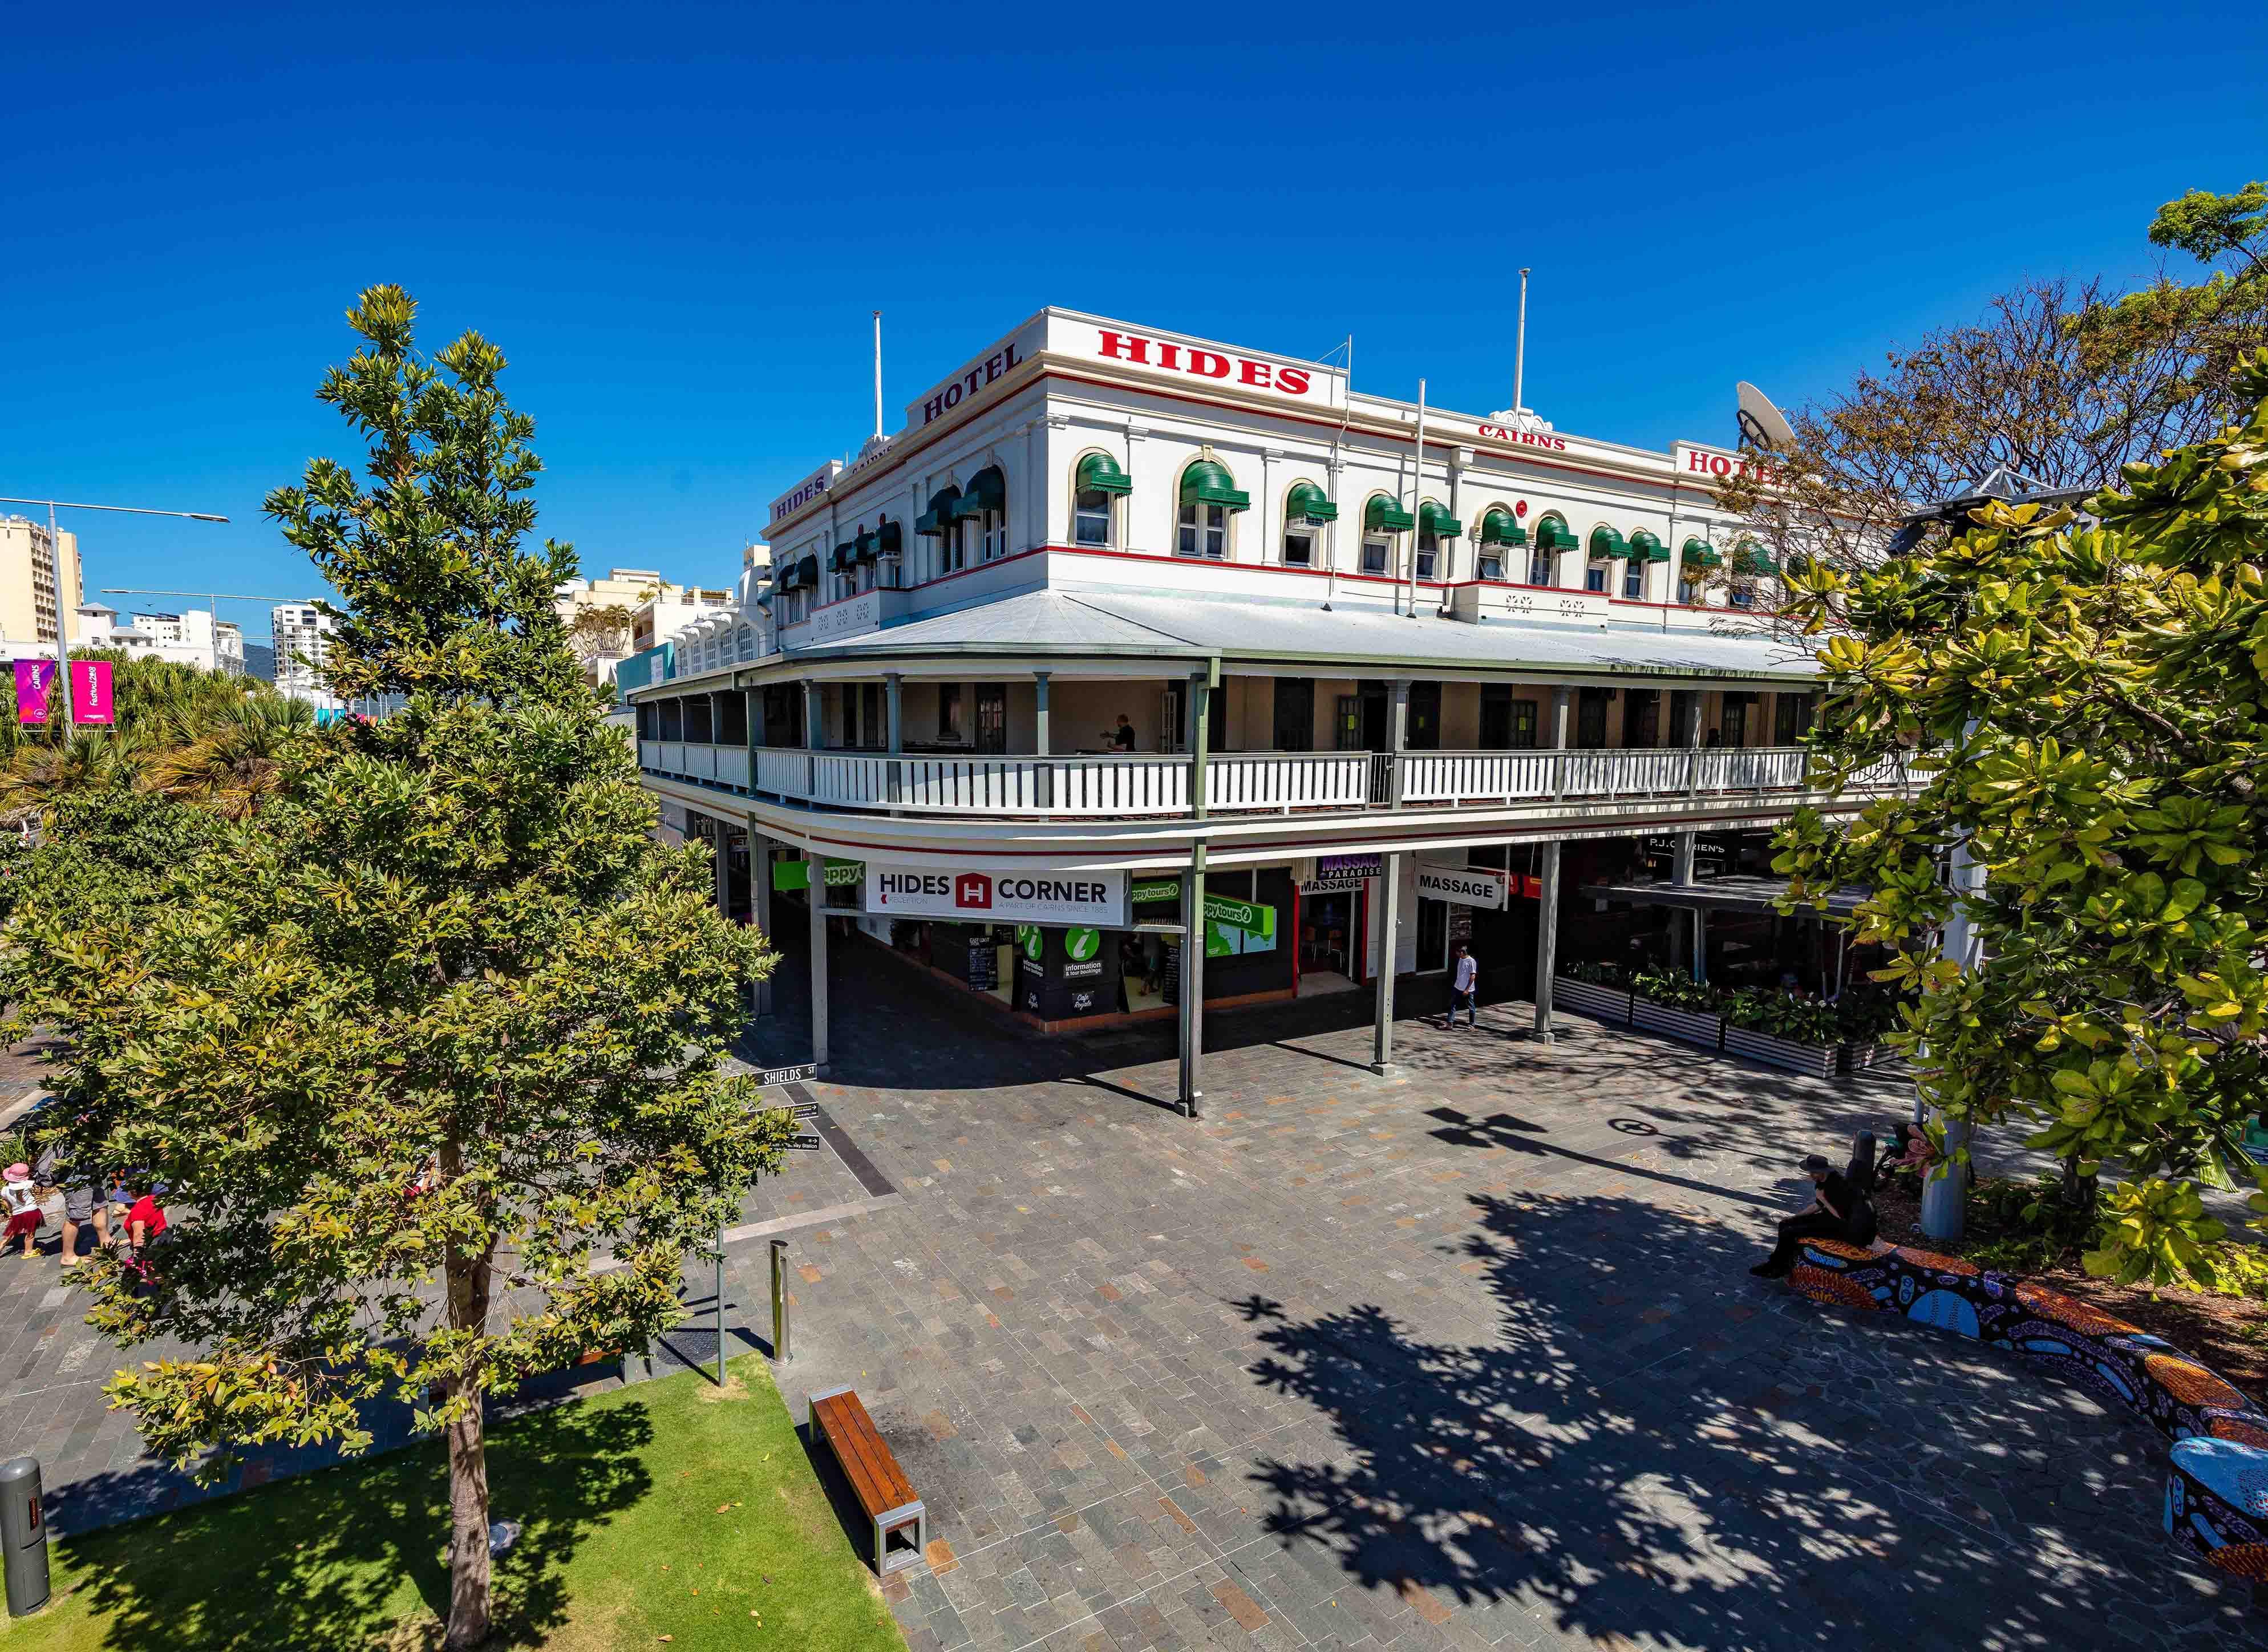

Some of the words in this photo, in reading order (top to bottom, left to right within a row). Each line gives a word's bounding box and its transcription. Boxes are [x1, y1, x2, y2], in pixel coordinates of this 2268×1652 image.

[1098, 330, 1311, 395] HIDES
[924, 342, 1022, 425] HOTEL
[1479, 424, 1566, 451] CAIRNS
[776, 475, 825, 520] HIDES
[31, 665, 41, 690] CAIRNS
[1329, 867, 1381, 878] PARADISE
[880, 873, 950, 896] HIDES
[998, 878, 1107, 904] CORNER
[1301, 878, 1362, 892] MASSAGE
[1419, 875, 1493, 899] MASSAGE
[1037, 904, 1065, 913] CAIRNS
[1074, 1000, 1092, 1011] Royale
[764, 1068, 801, 1084] SHIELDS
